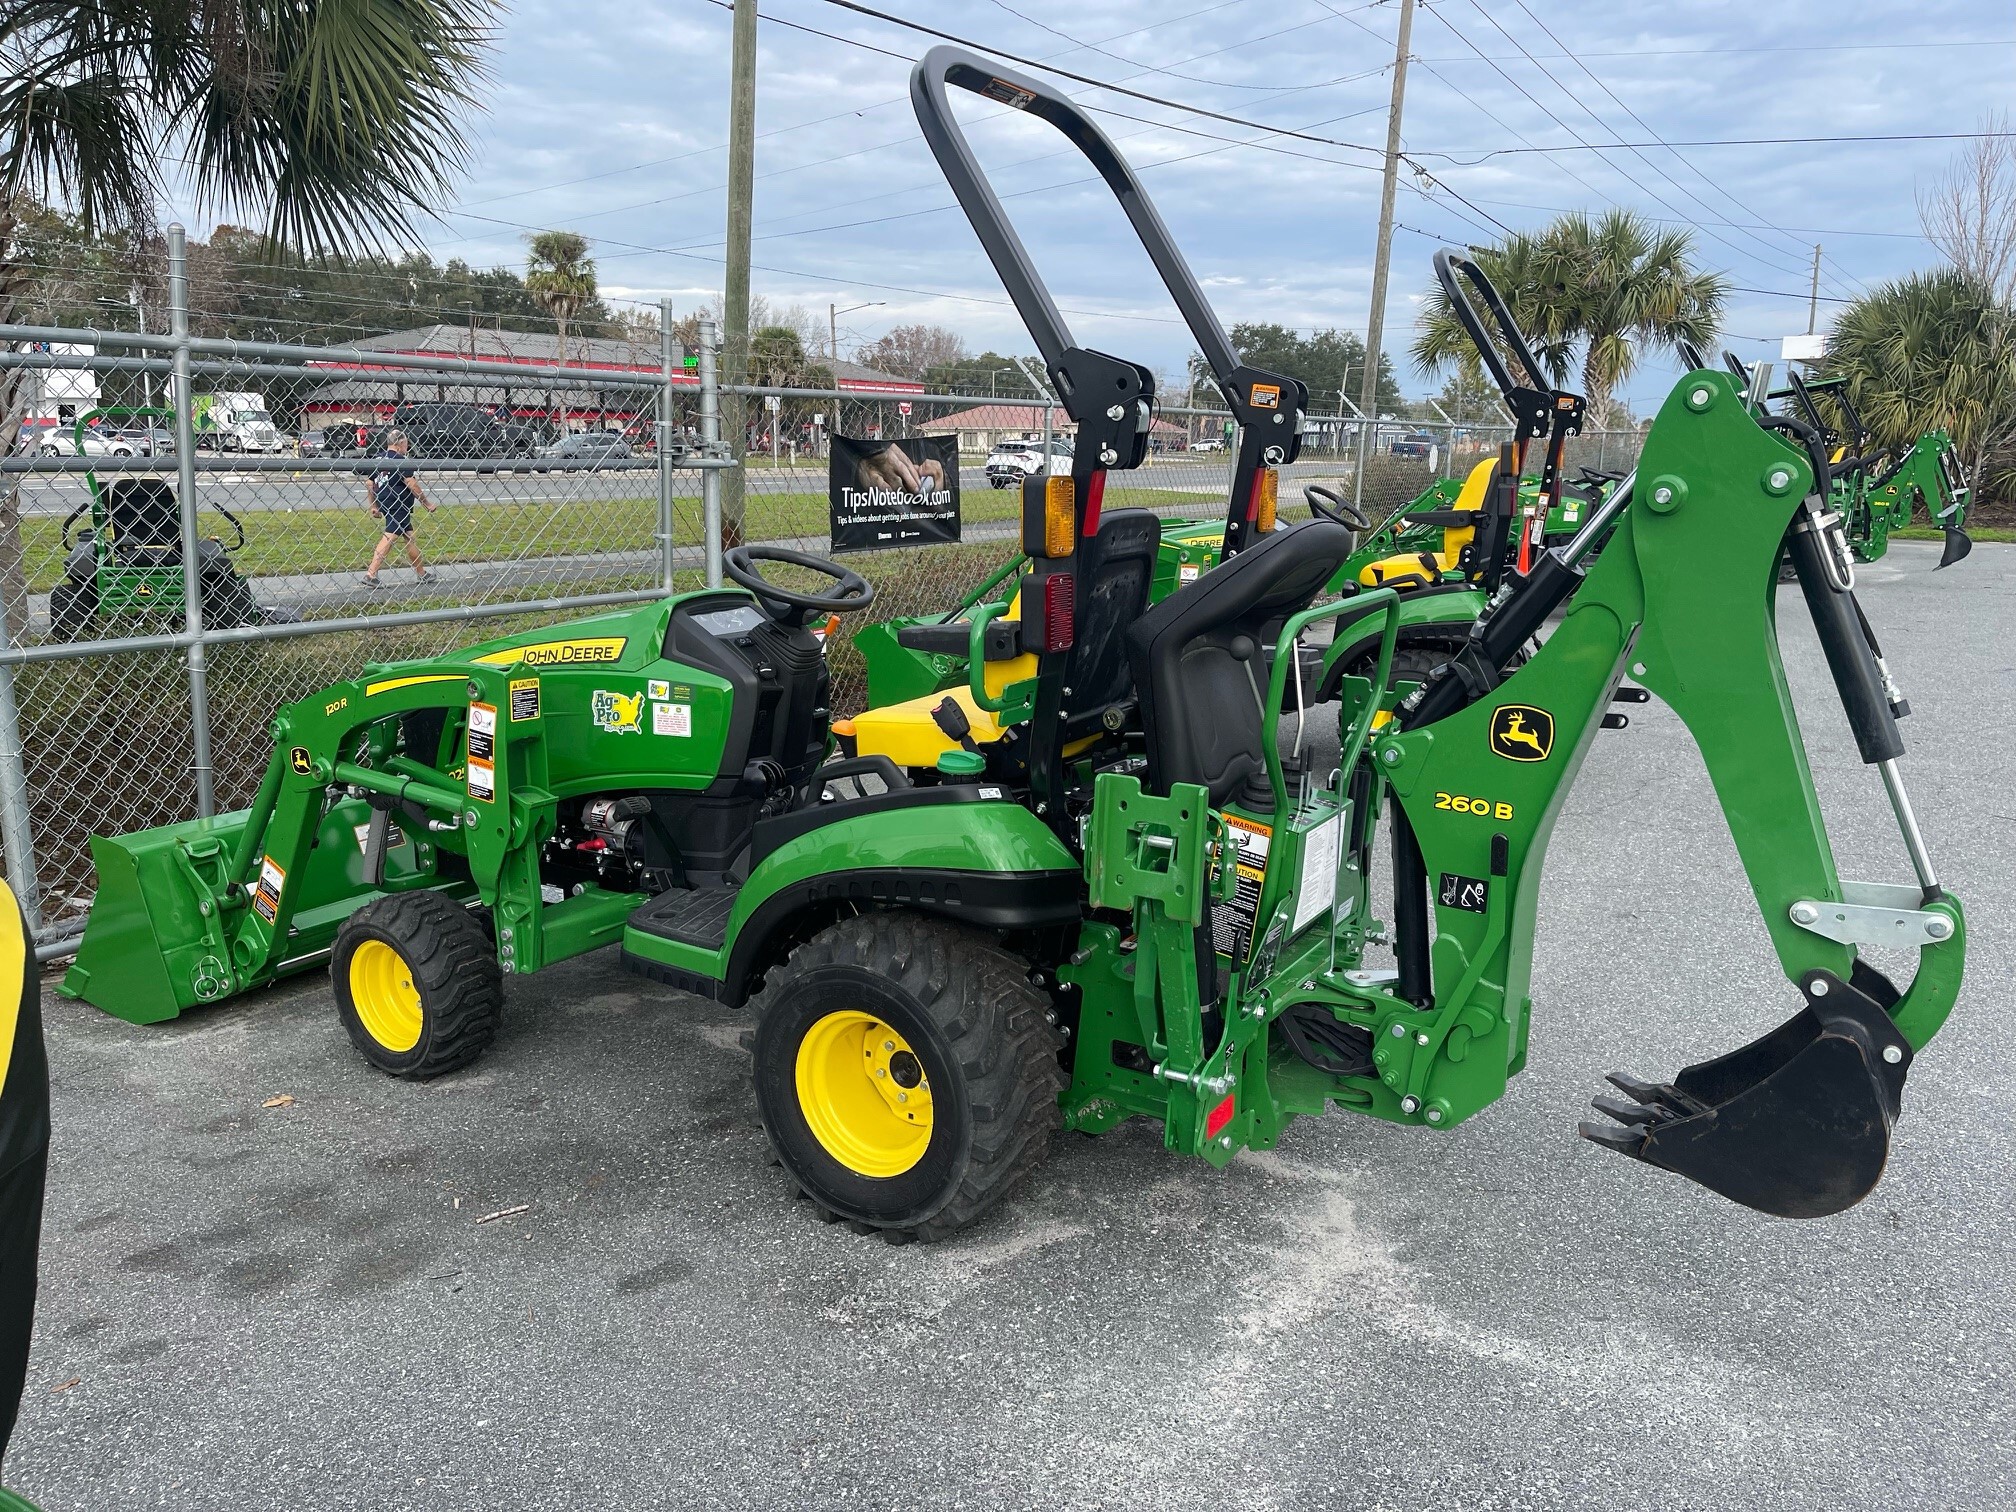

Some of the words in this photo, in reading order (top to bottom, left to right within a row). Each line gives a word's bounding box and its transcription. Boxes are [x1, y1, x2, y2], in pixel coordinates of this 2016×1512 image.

[841, 486, 951, 513] TipsNotebook.com
[837, 515, 848, 527] Tips
[848, 515, 853, 524] &
[852, 514, 868, 524] videos
[868, 513, 882, 523] about
[882, 512, 900, 524] getting
[899, 511, 910, 522] jobs
[522, 649, 559, 663] JOHN
[561, 645, 614, 661] DEERE
[325, 701, 341, 717] 120
[340, 697, 348, 709] R
[596, 708, 621, 724] Pro
[1434, 791, 1490, 816] 260
[1494, 801, 1514, 821] B
[1232, 819, 1268, 836] WARNING
